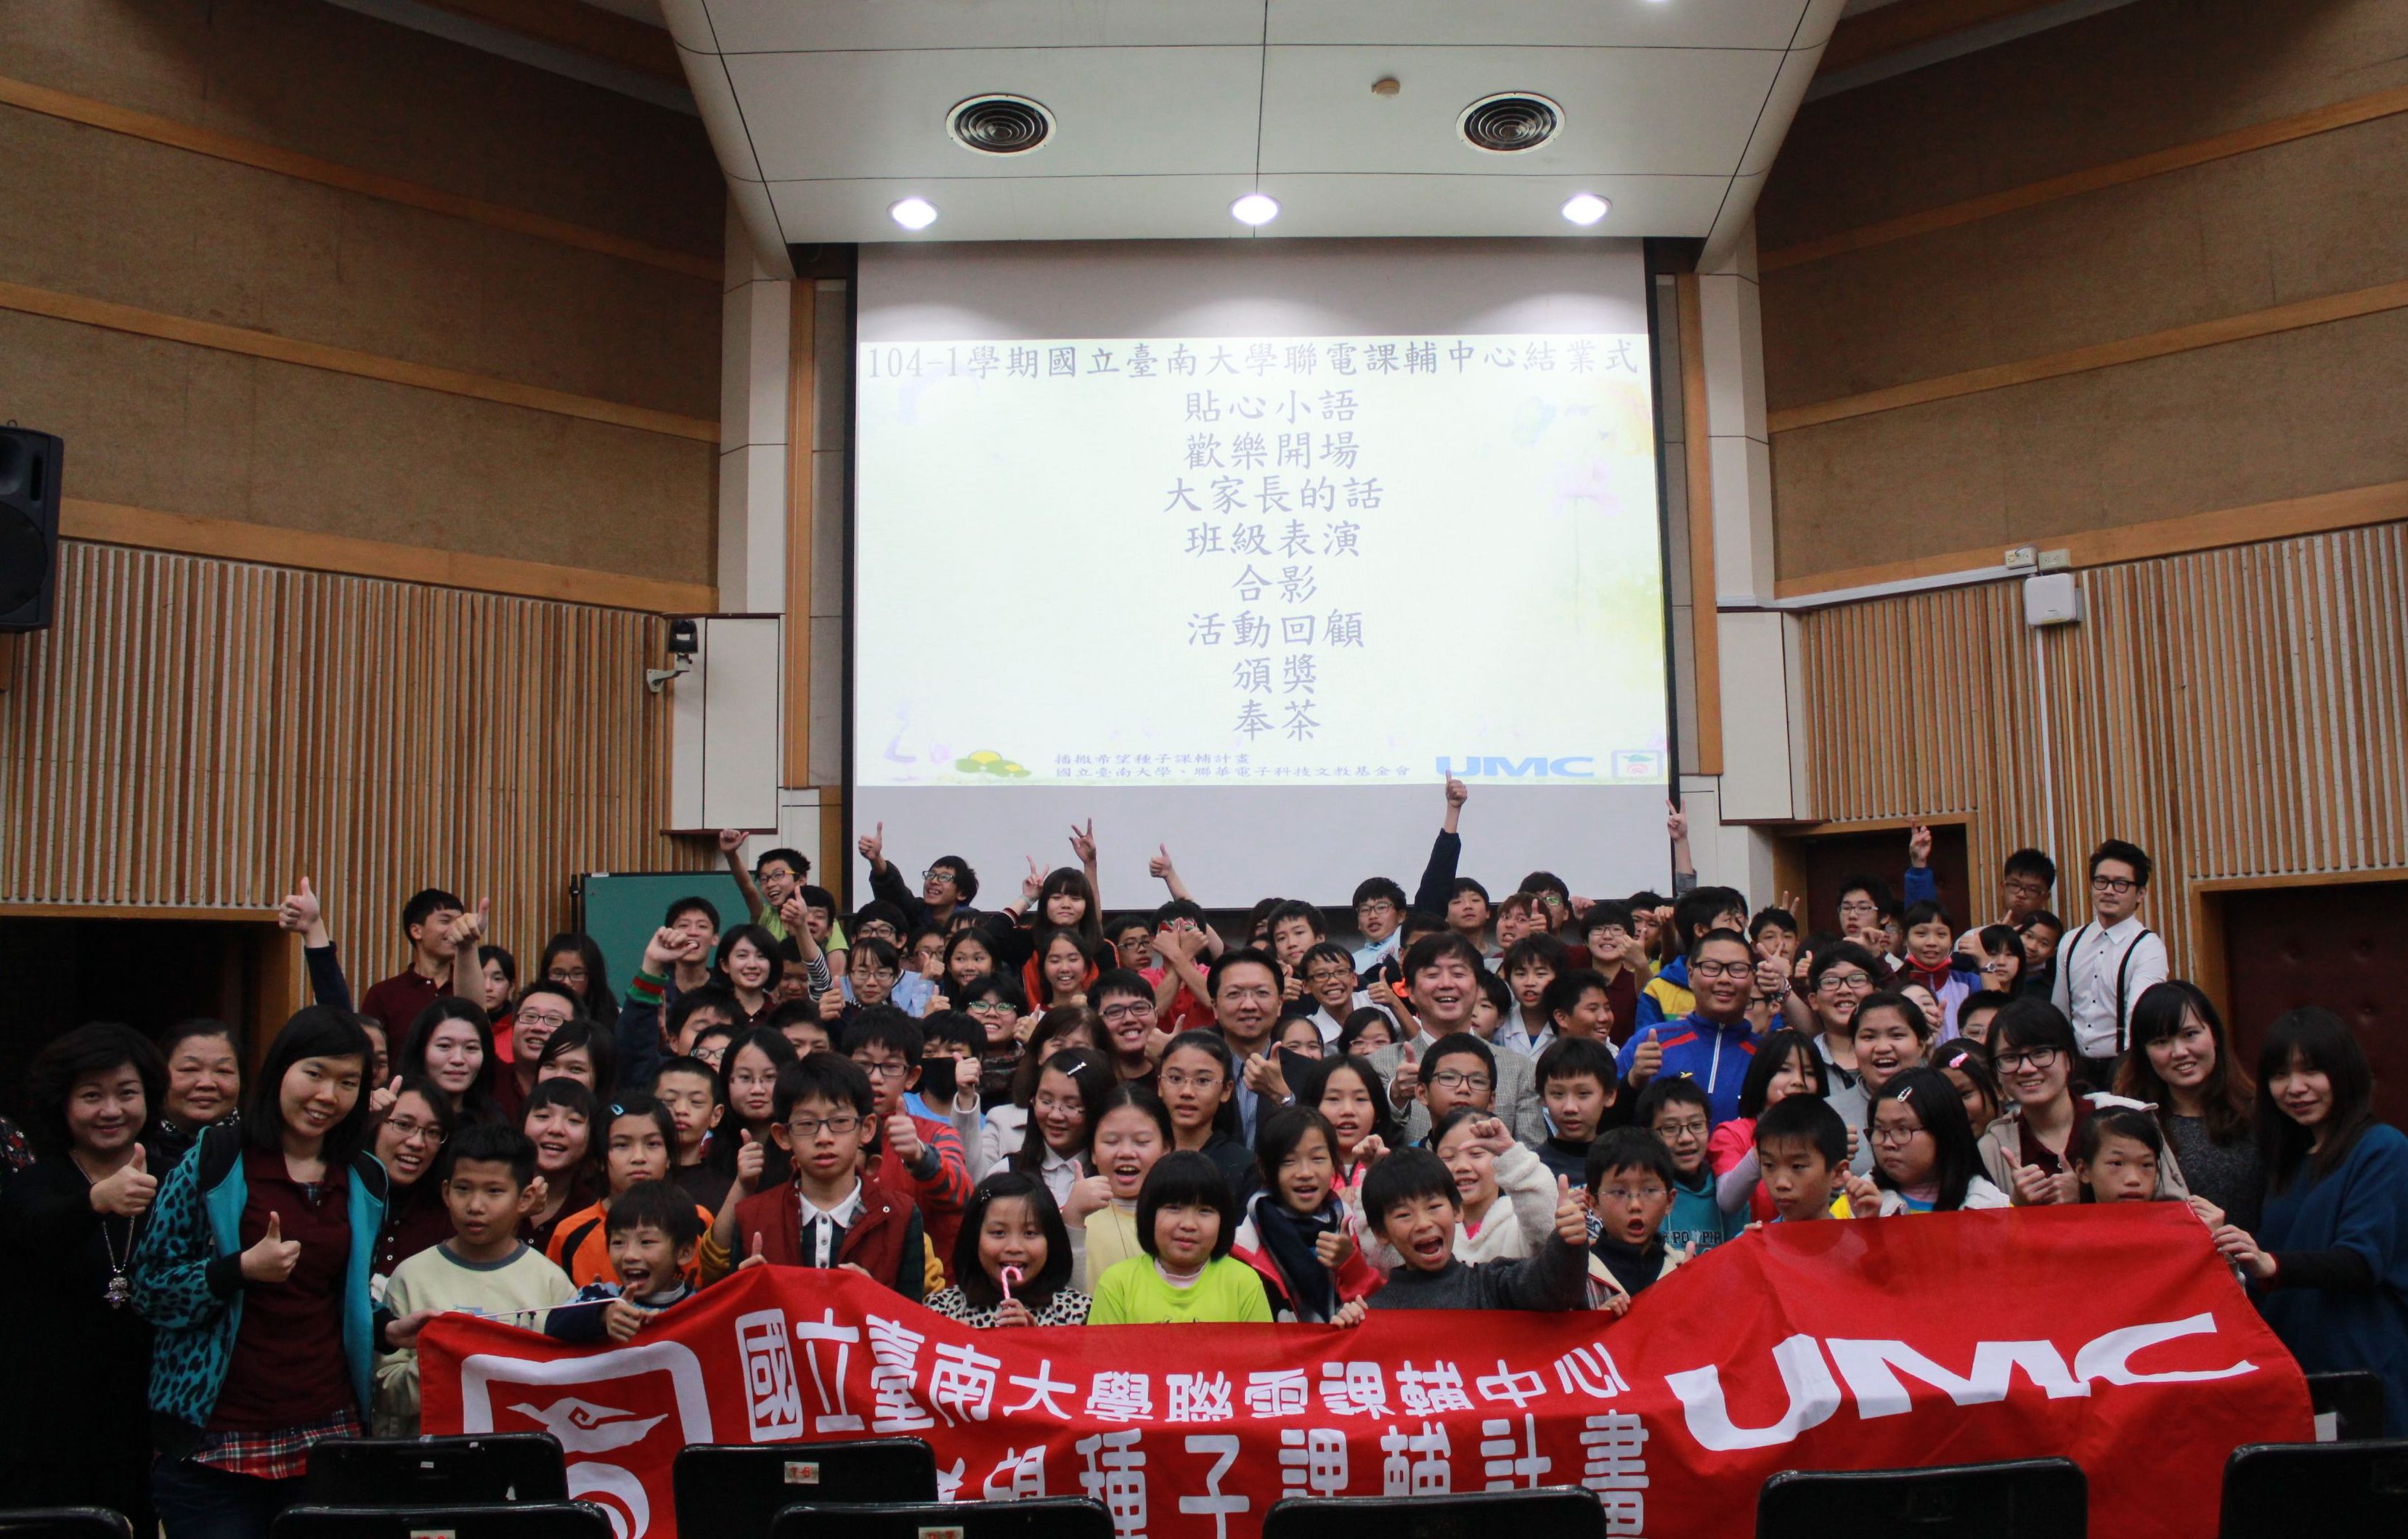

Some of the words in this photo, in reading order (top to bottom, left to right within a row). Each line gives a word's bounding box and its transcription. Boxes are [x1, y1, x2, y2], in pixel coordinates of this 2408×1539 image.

[869, 338, 1638, 380] 104-1學期國立臺南大學聯電課輔中心結業式
[1185, 389, 1359, 423] 貼心小語
[1183, 431, 1360, 471] 歡樂開場
[1163, 475, 1385, 514] 大家長的話
[1184, 518, 1361, 559] 班級表演
[1232, 564, 1317, 604] 合影
[1188, 609, 1364, 649] 活動回顧
[1232, 654, 1316, 694] 頒獎
[1233, 699, 1321, 742] 奉茶
[1436, 756, 1595, 777] UMC
[735, 1307, 1631, 1442] 國立臺南大學聯電課輔中心
[1664, 1312, 2260, 1452] UMC
